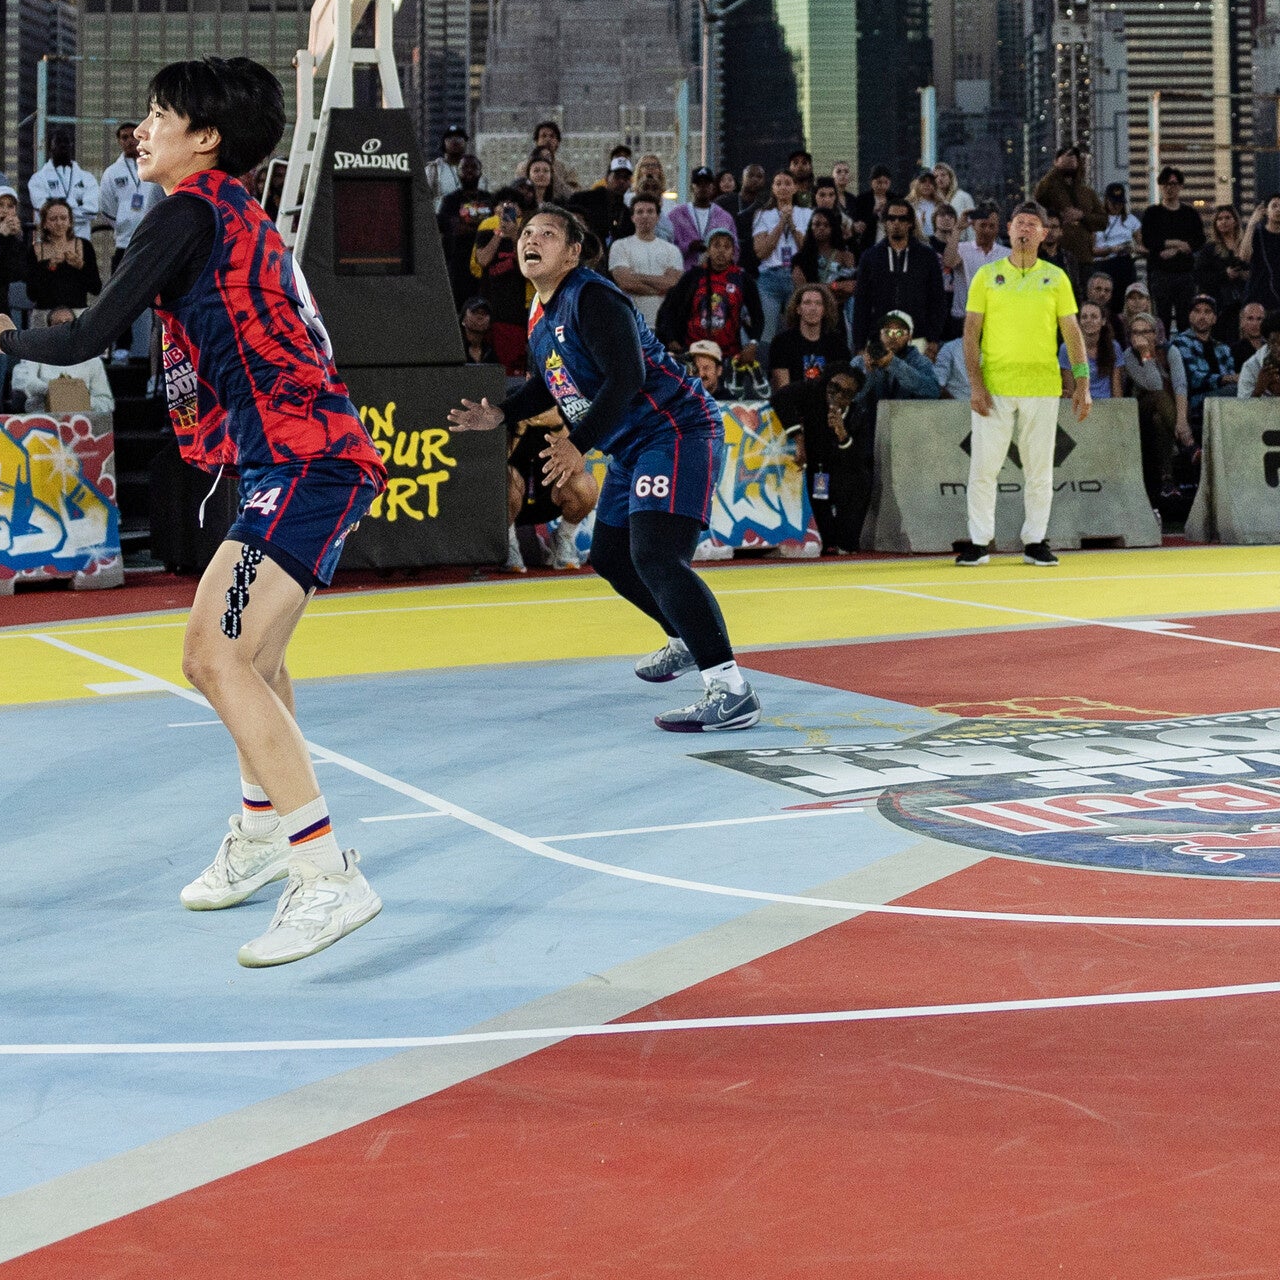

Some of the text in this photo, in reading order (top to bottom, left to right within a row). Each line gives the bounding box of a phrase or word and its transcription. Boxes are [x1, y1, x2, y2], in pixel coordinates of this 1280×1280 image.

[334, 151, 410, 171] SPALDING
[635, 474, 670, 498] 68
[918, 727, 1111, 748] FINALS
[745, 741, 904, 757] 2024
